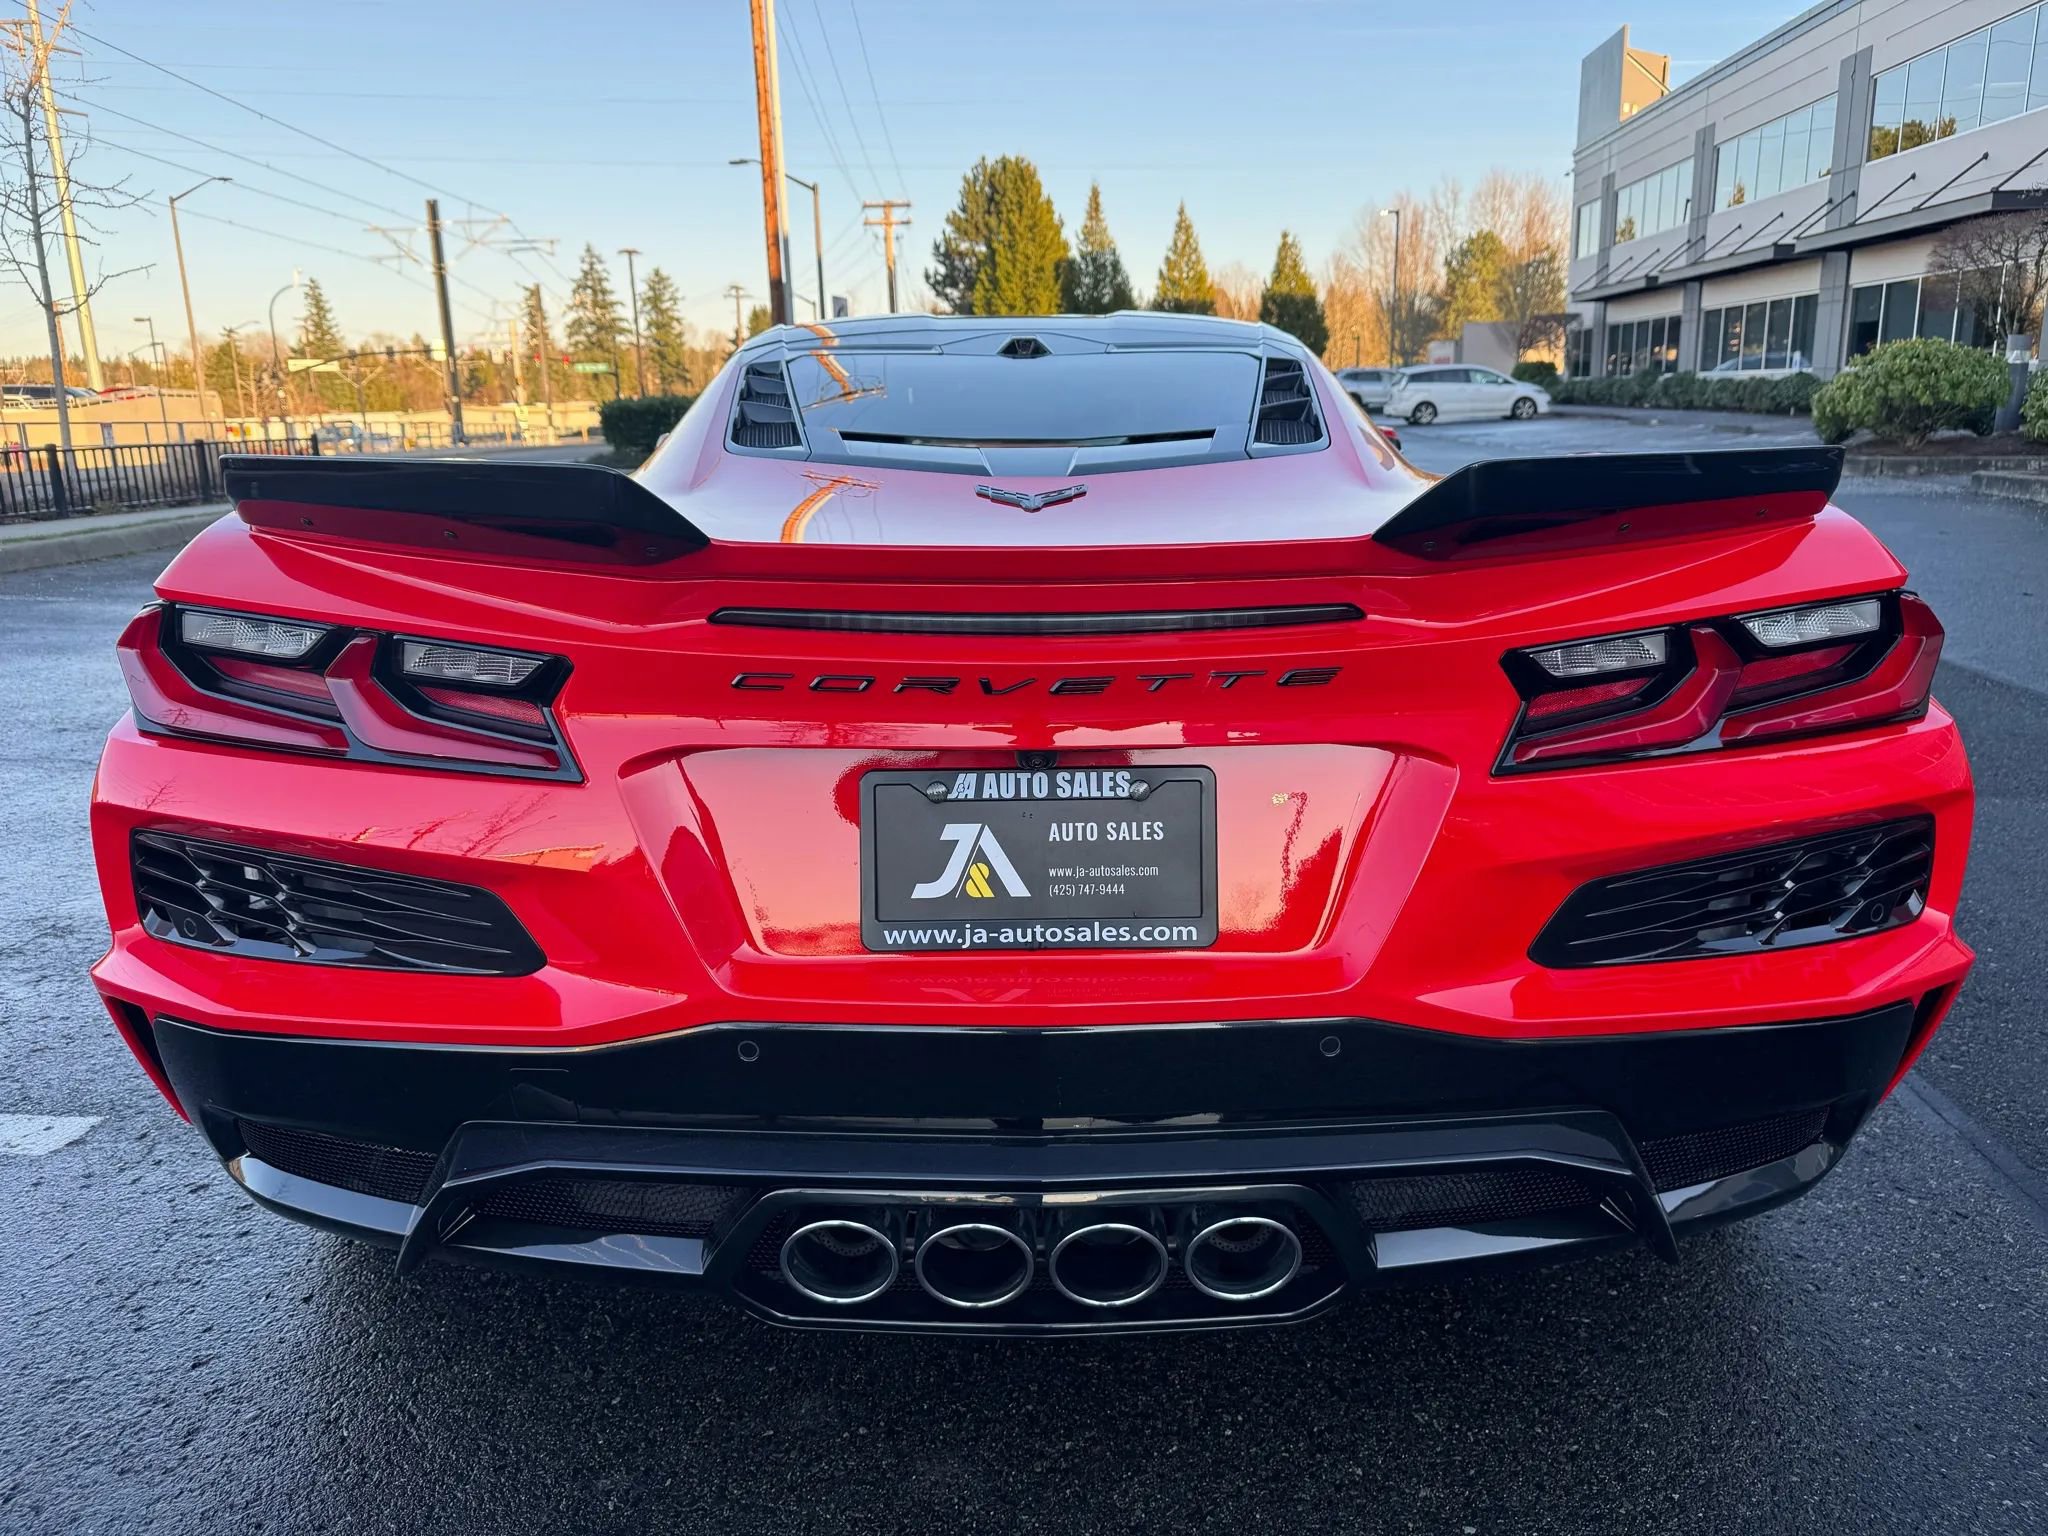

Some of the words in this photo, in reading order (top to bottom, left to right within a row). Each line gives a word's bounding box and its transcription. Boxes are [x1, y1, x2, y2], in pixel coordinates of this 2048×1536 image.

[730, 667, 1343, 695] CORVETTE
[982, 772, 1048, 798] AUTO
[1055, 771, 1131, 797] SALES
[1048, 822, 1098, 841] AUTO
[1106, 821, 1164, 840] SALES
[1048, 864, 1159, 878] www.ja-autosales.com
[1049, 884, 1076, 896] (425)
[1078, 883, 1125, 895] 747-9444
[884, 922, 1197, 948] www.ja-autosales.com
